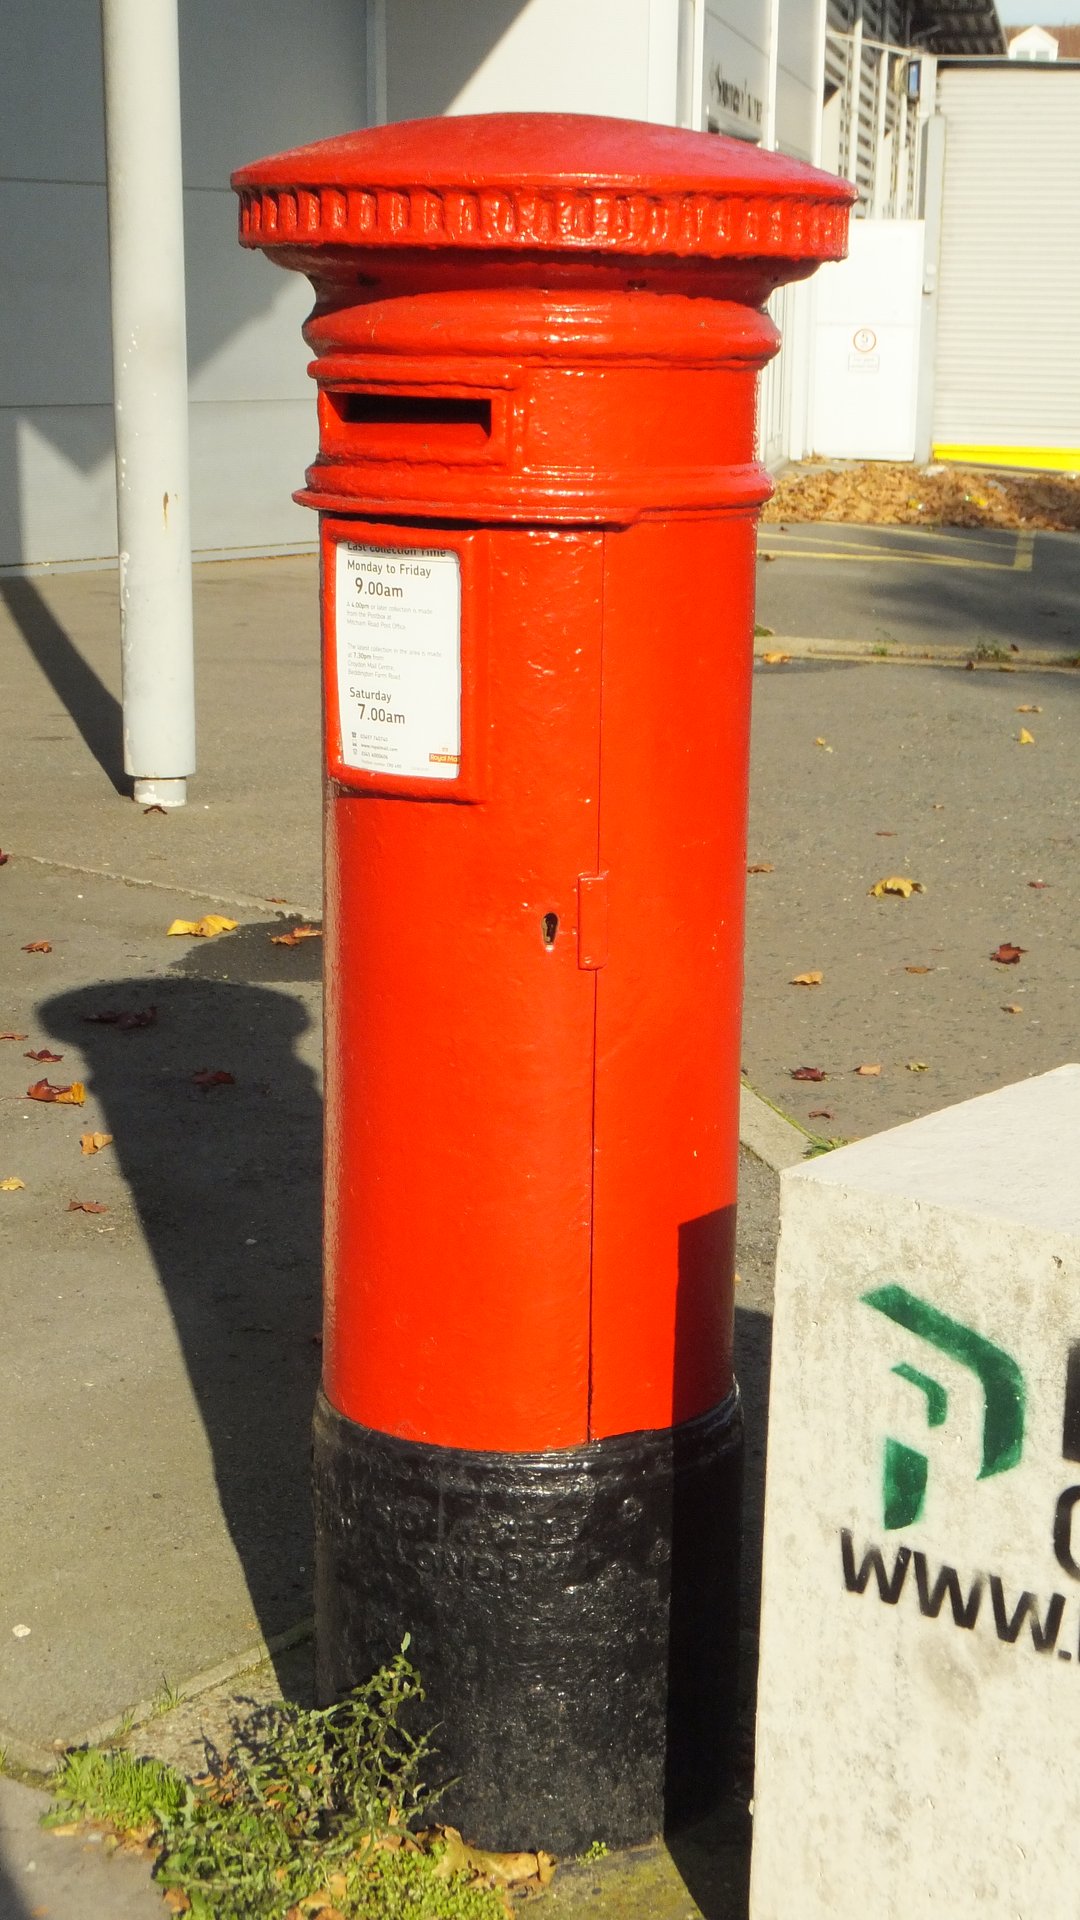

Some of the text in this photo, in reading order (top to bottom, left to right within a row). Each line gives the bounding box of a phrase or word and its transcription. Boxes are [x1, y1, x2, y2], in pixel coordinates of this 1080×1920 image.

[347, 542, 367, 552] Last
[347, 560, 431, 579] Monday to Friday
[355, 577, 403, 598] 9.00am
[353, 652, 371, 660] 7.30pm
[349, 686, 392, 704] Saturday
[357, 702, 405, 725] 7.00am
[430, 754, 447, 762] Royal
[841, 1528, 1080, 1663] www.
